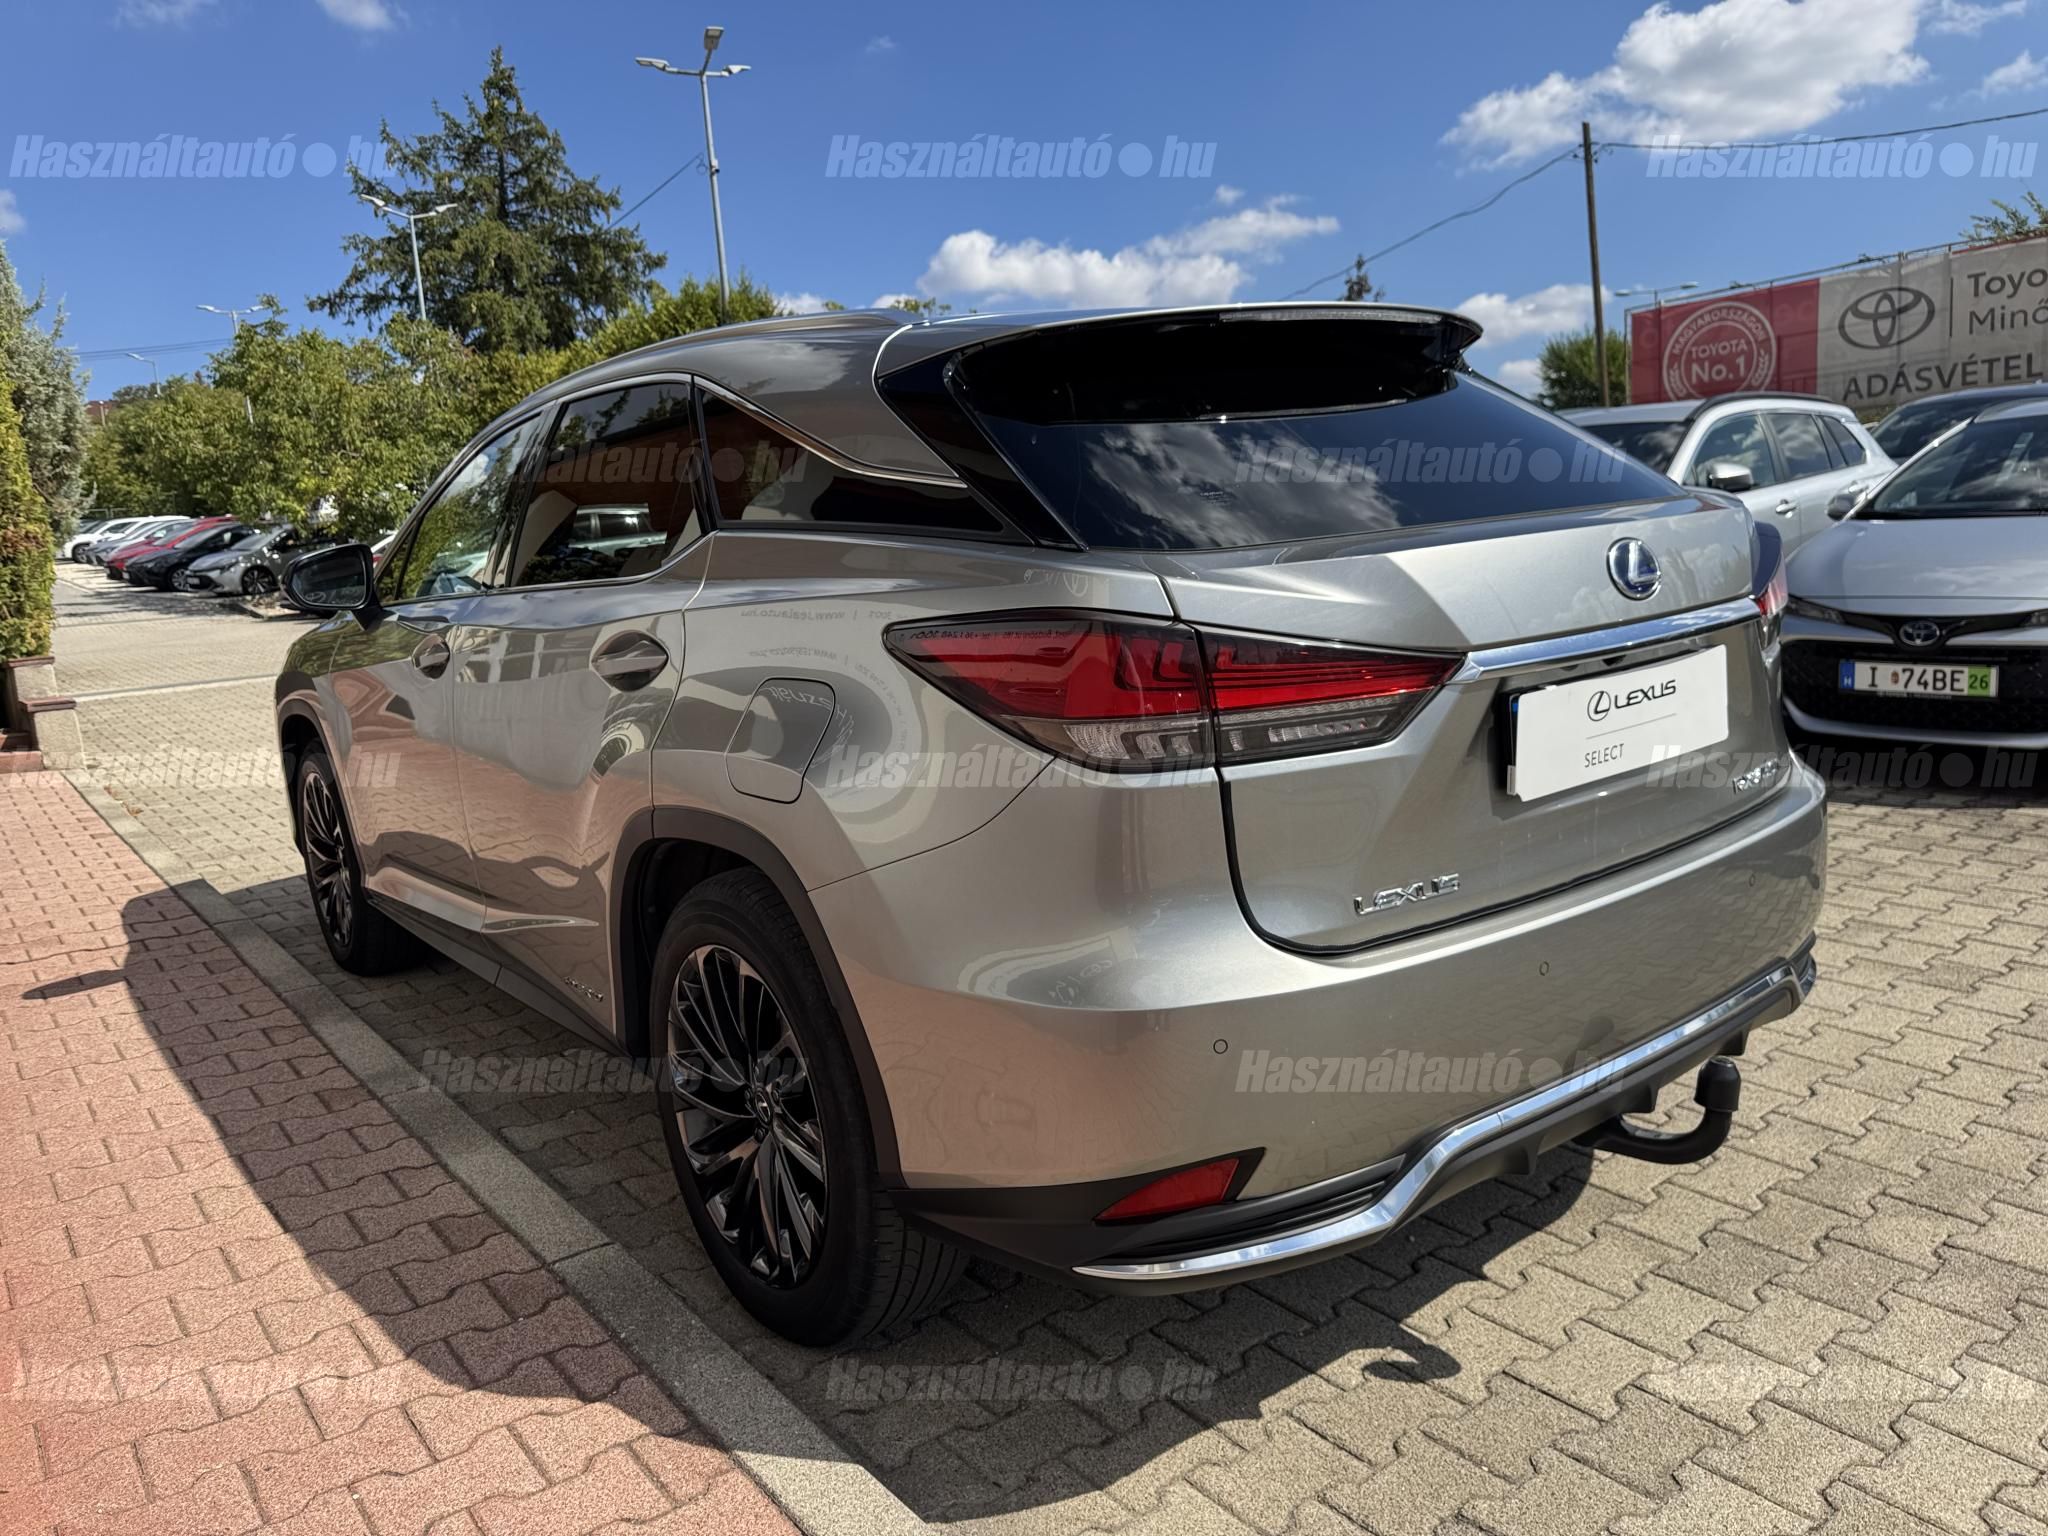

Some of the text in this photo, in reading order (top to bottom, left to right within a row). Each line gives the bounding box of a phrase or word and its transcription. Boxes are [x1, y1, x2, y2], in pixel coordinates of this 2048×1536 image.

[1691, 340, 1748, 358] TOYOTA
[1843, 353, 2043, 400] ADÁSVÉTEL
[1902, 668, 1965, 692] 74BE
[1969, 674, 1989, 690] 26
[1614, 679, 1677, 710] LEXUS
[1584, 743, 1625, 769] SELECT
[1354, 873, 1460, 915] LEXUS
